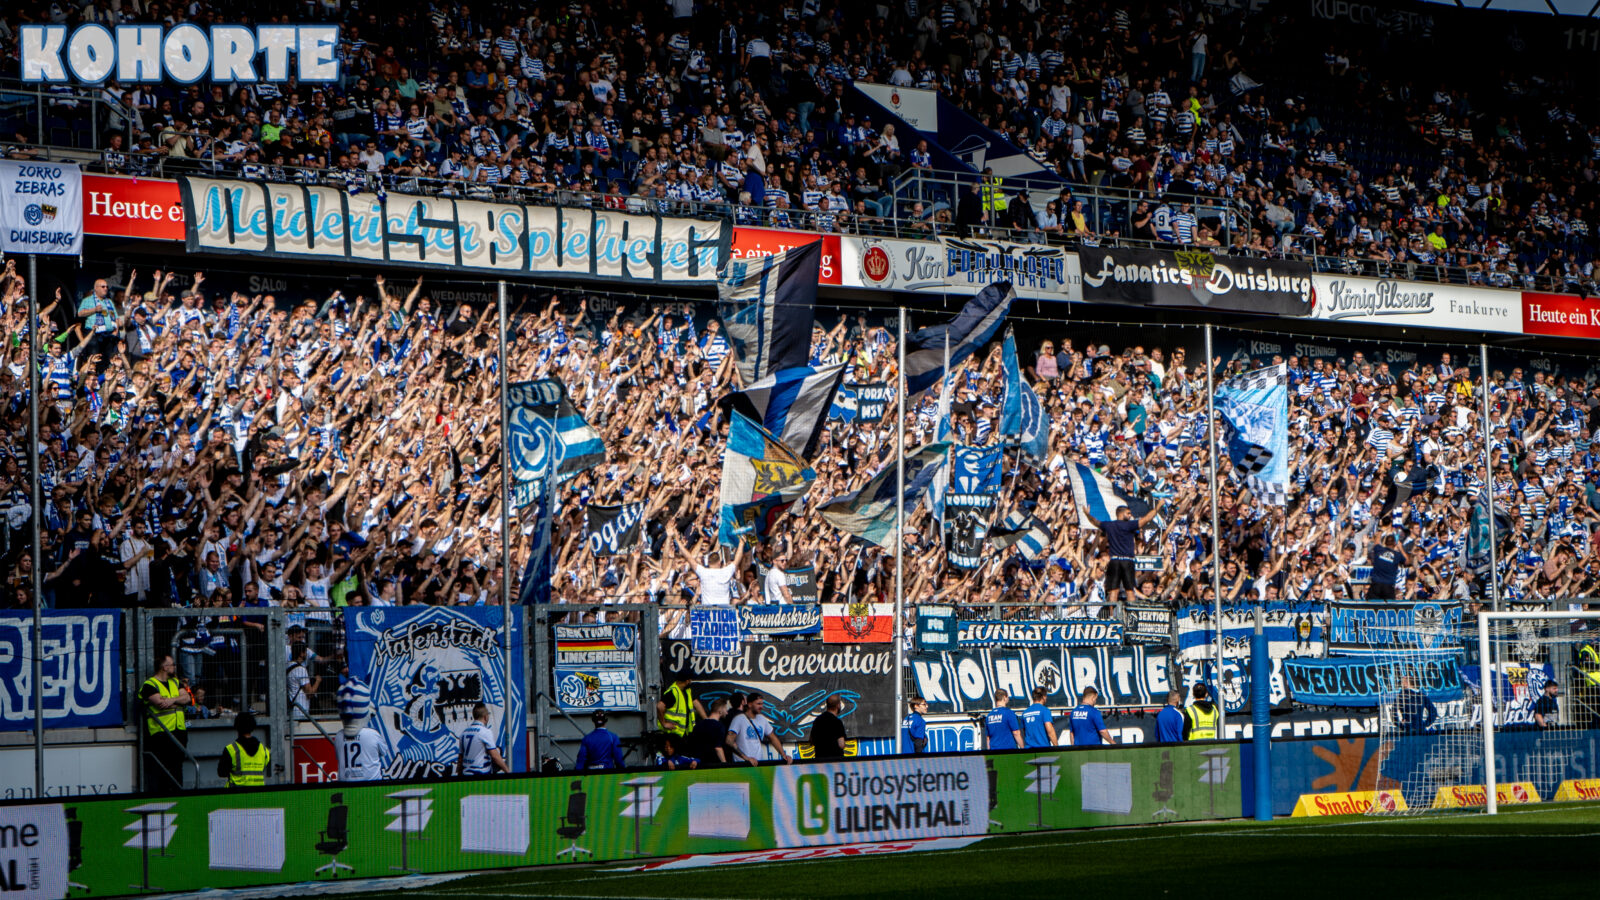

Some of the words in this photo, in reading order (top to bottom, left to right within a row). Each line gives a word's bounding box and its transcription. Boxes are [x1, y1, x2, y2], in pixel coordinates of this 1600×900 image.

[17, 165, 62, 181] ZORRO
[15, 180, 65, 197] ZEBRAS
[89, 192, 163, 220] Heute
[197, 185, 480, 252] Meidericher
[10, 229, 74, 247] DUISBURG
[1084, 255, 1194, 288] Fanatics
[1205, 263, 1311, 302] Duisburg
[1449, 299, 1508, 317] Fankurve
[1529, 303, 1566, 325] Heute
[1568, 308, 1587, 326] ein
[861, 404, 884, 418] MSV
[691, 609, 737, 622] SEKTION
[740, 606, 819, 630] Freundeskreis
[557, 626, 612, 639] SEKTION
[691, 622, 737, 636] STADION
[374, 618, 498, 666] Hafenstadt
[558, 651, 634, 664] LINKSRHEIN
[758, 645, 893, 681] Generation
[344, 743, 362, 769] 12
[834, 769, 969, 800] Bürosysteme
[1314, 795, 1371, 815] Sinalco
[835, 801, 961, 834] LILIENTHAL
